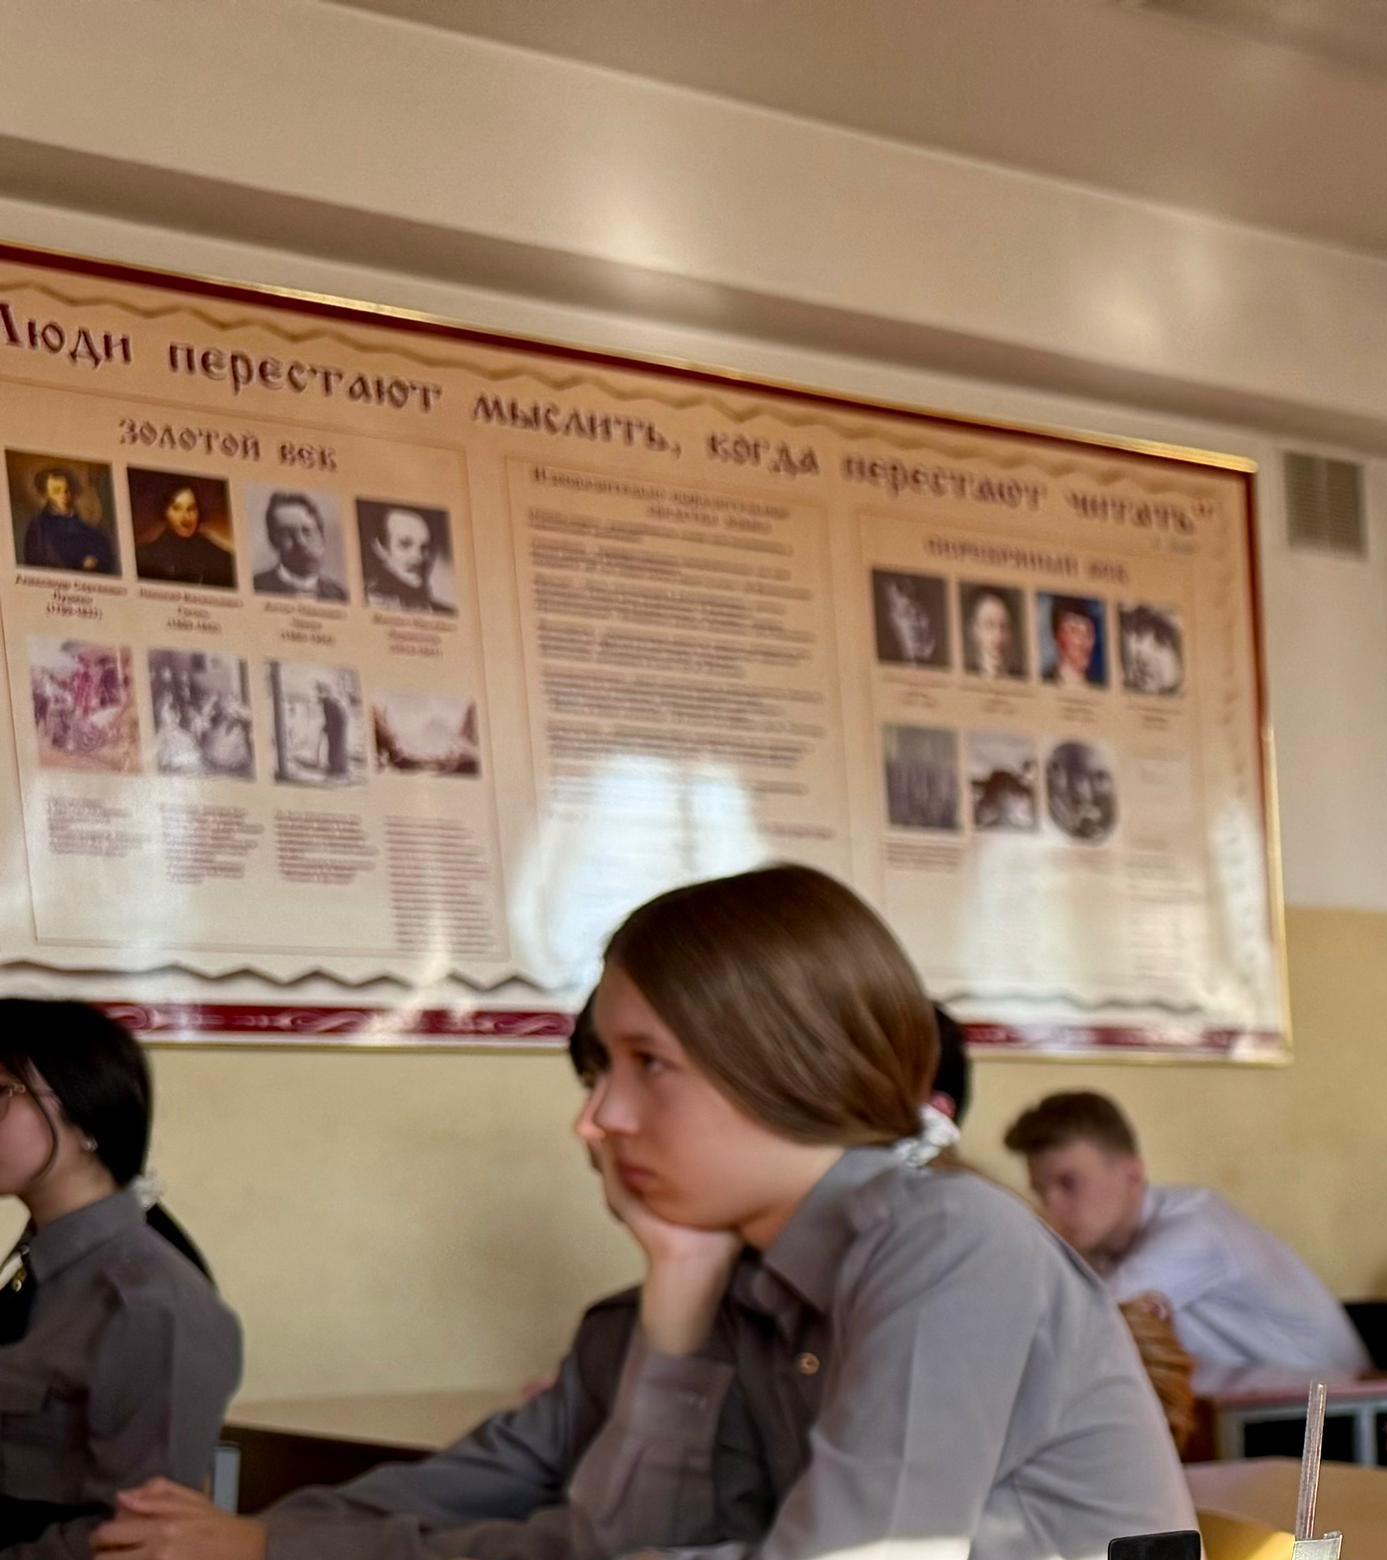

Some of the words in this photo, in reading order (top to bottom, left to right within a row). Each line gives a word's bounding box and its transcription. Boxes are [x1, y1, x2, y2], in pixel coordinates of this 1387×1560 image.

[168, 339, 442, 415] перестают
[472, 392, 682, 460] мыслить,
[706, 430, 820, 478] когда
[841, 451, 1048, 512] перестают
